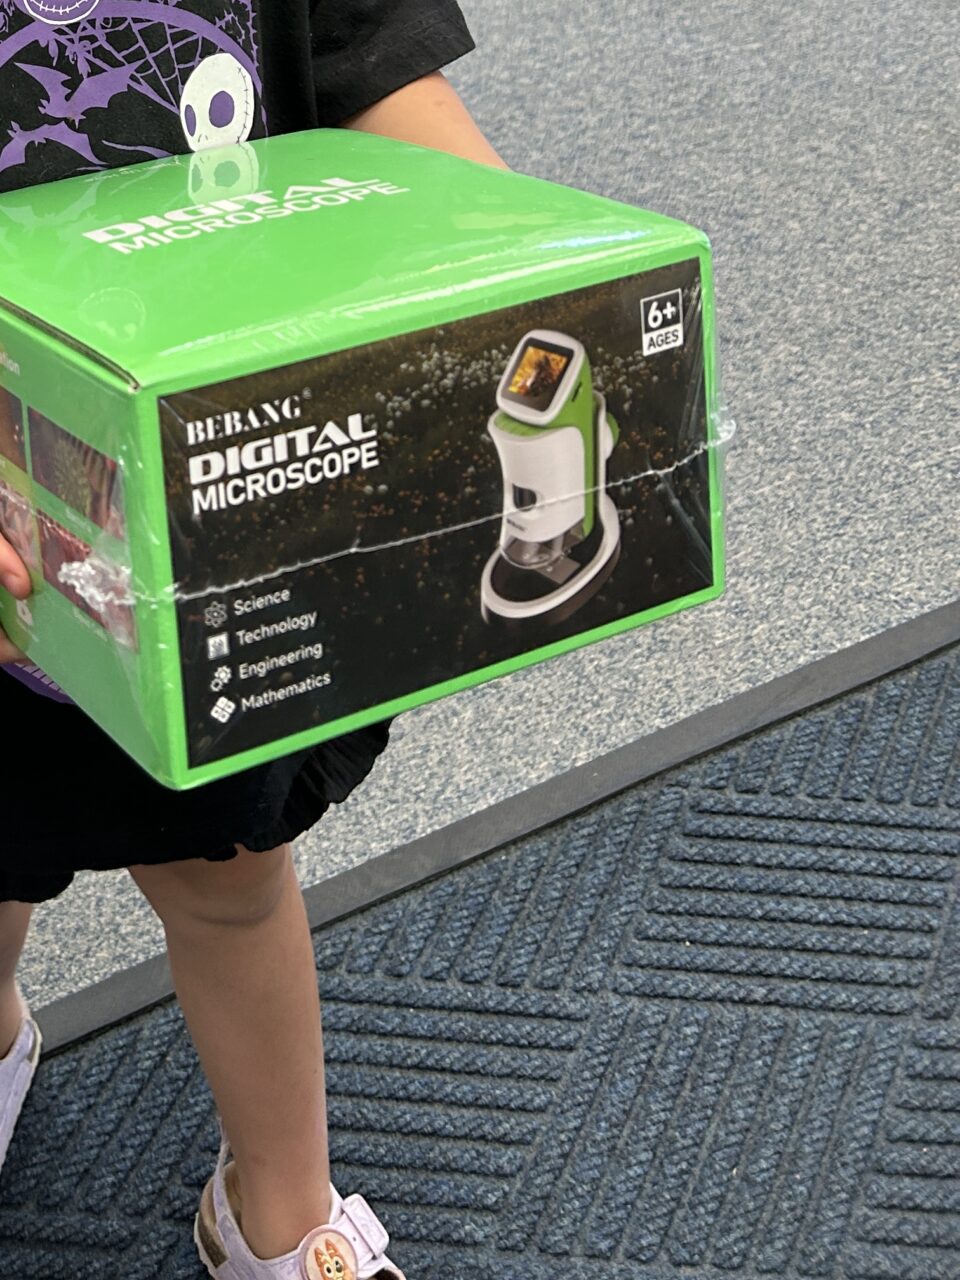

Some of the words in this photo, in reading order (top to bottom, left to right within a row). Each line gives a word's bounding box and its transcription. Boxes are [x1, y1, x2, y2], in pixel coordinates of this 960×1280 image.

[81, 177, 381, 244] DIGITAL
[107, 181, 411, 255] MICROSCOPE
[647, 301, 677, 329] 6+
[647, 329, 679, 351] AGES
[189, 413, 377, 486] DIGITAL
[191, 440, 380, 516] MICROSCOPE
[233, 589, 291, 616] Science
[235, 610, 318, 646] Technology
[238, 643, 324, 680] Engineering
[241, 672, 332, 712] Mathematics
